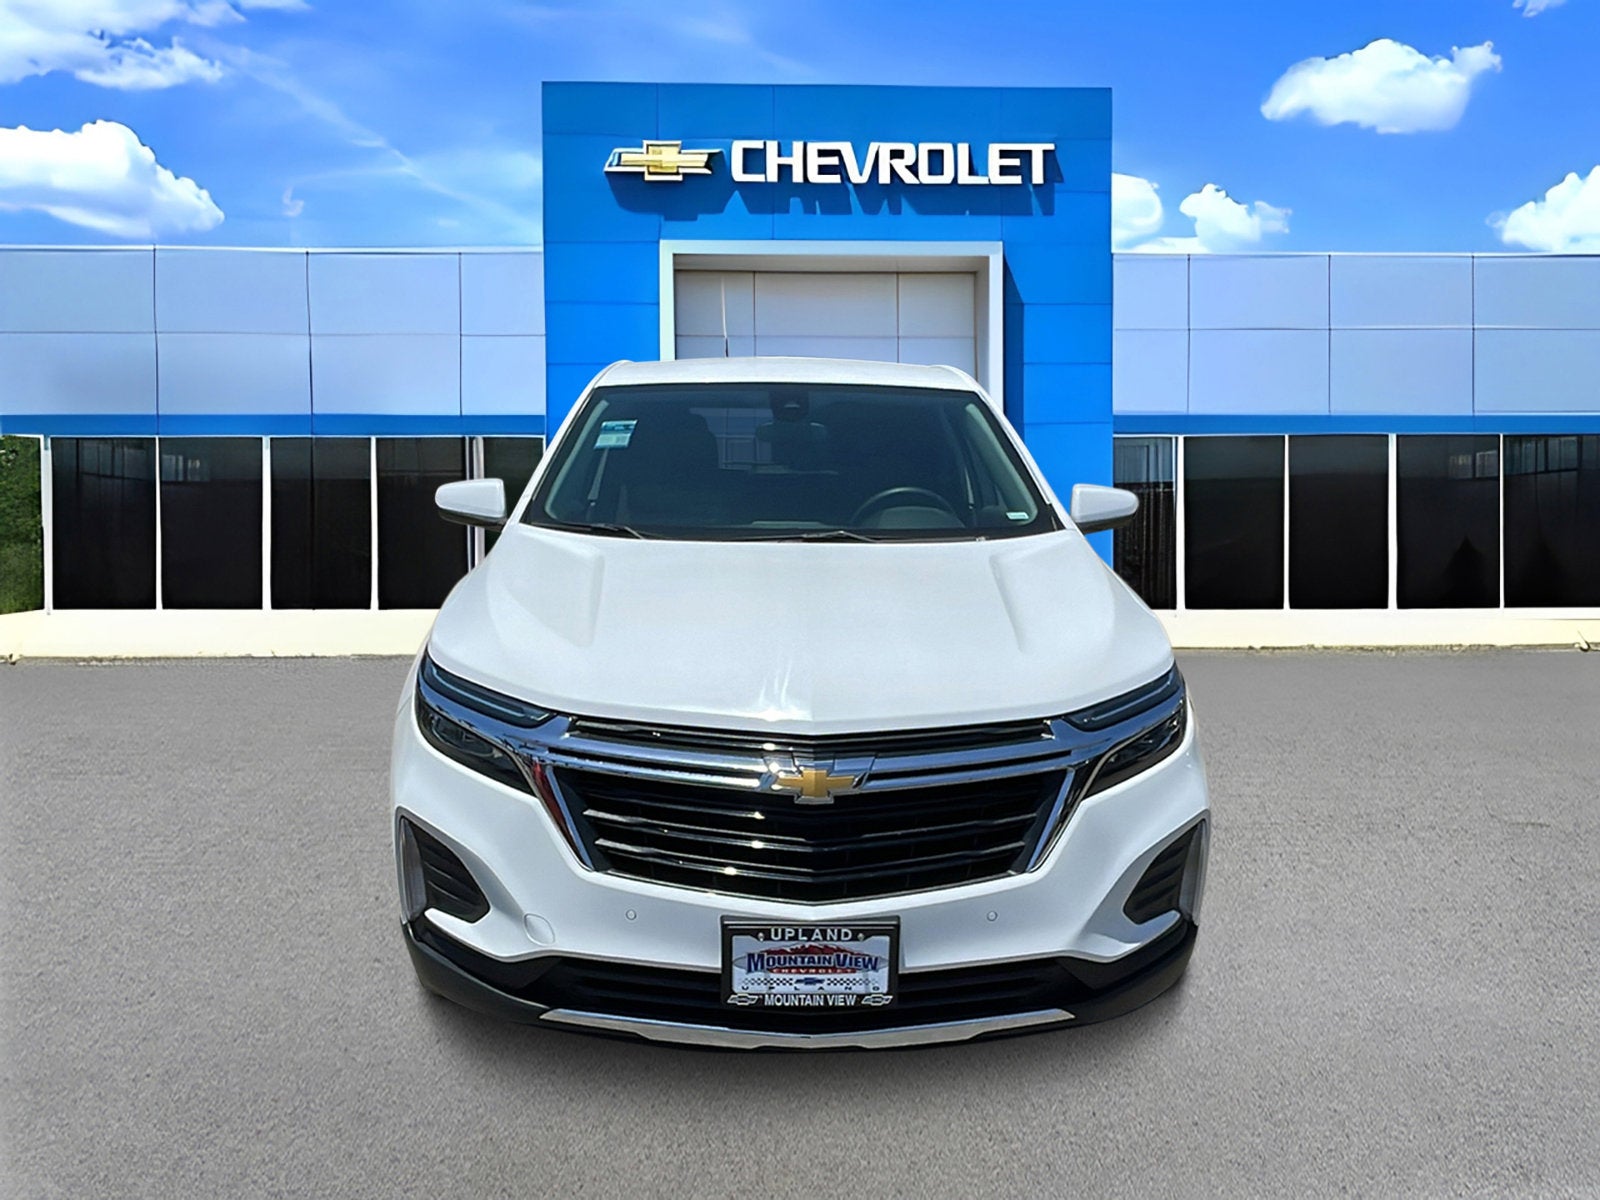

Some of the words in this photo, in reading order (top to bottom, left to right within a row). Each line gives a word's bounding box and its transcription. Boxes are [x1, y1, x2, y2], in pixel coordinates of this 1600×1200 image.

[731, 139, 1055, 185] CHEVROLET
[771, 928, 852, 941] UPLAND
[764, 994, 825, 1006] MOUNTAIN
[828, 994, 857, 1006] VIEW
